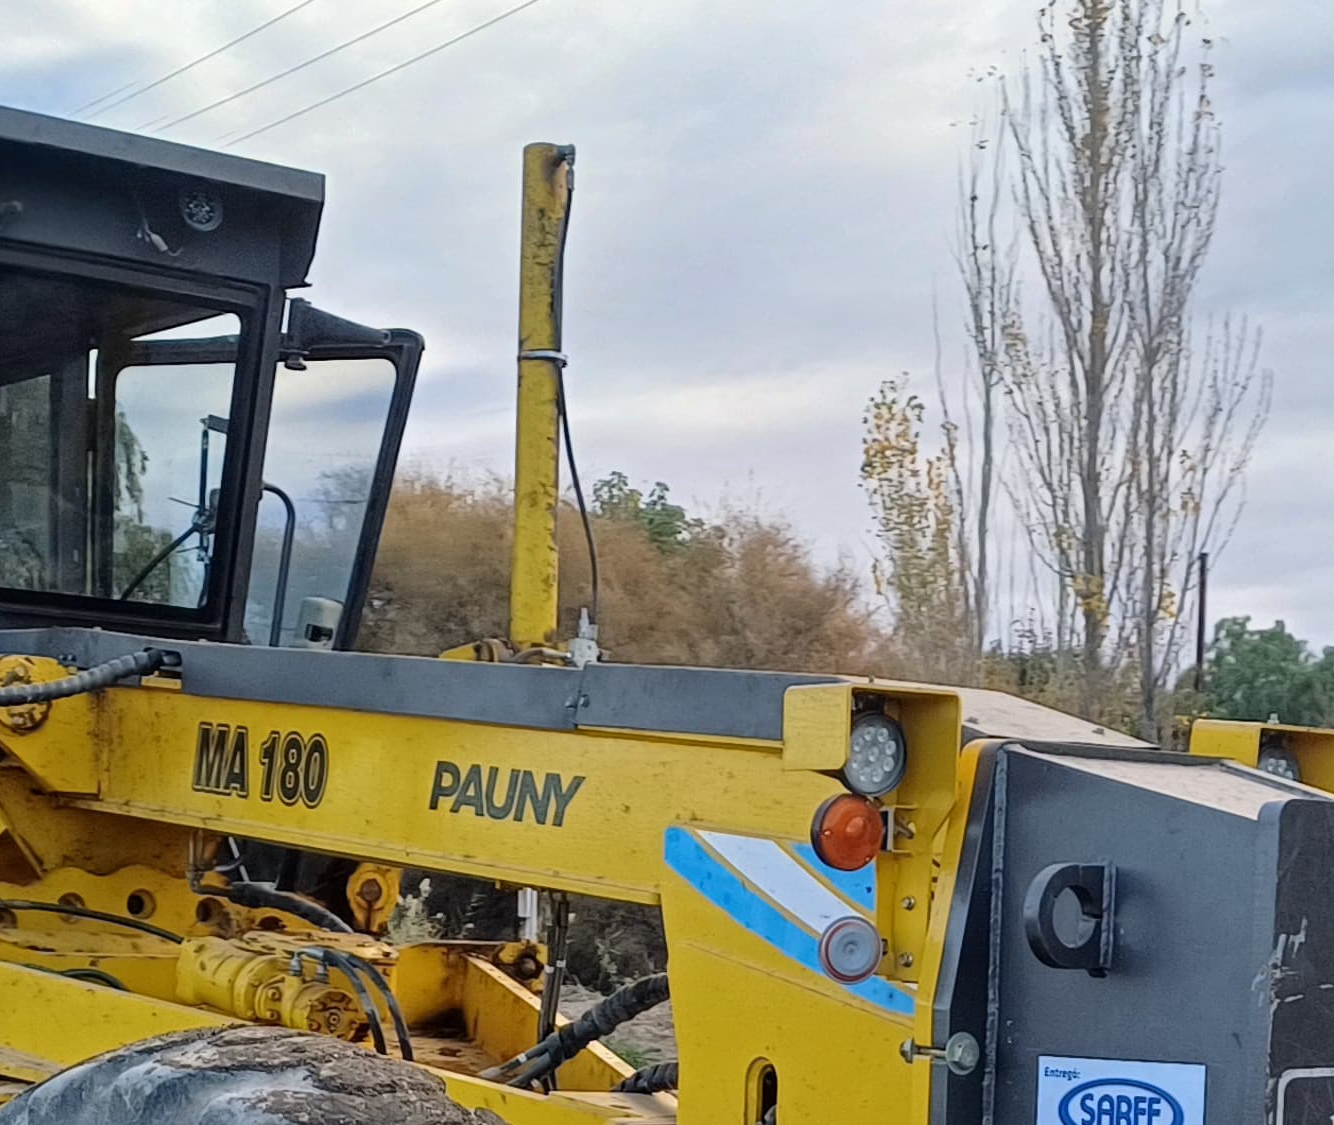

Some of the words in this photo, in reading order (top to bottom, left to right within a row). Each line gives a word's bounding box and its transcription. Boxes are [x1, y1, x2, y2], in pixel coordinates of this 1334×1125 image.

[192, 722, 249, 799] MA
[259, 730, 329, 809] 180
[428, 760, 586, 827] PAUNY
